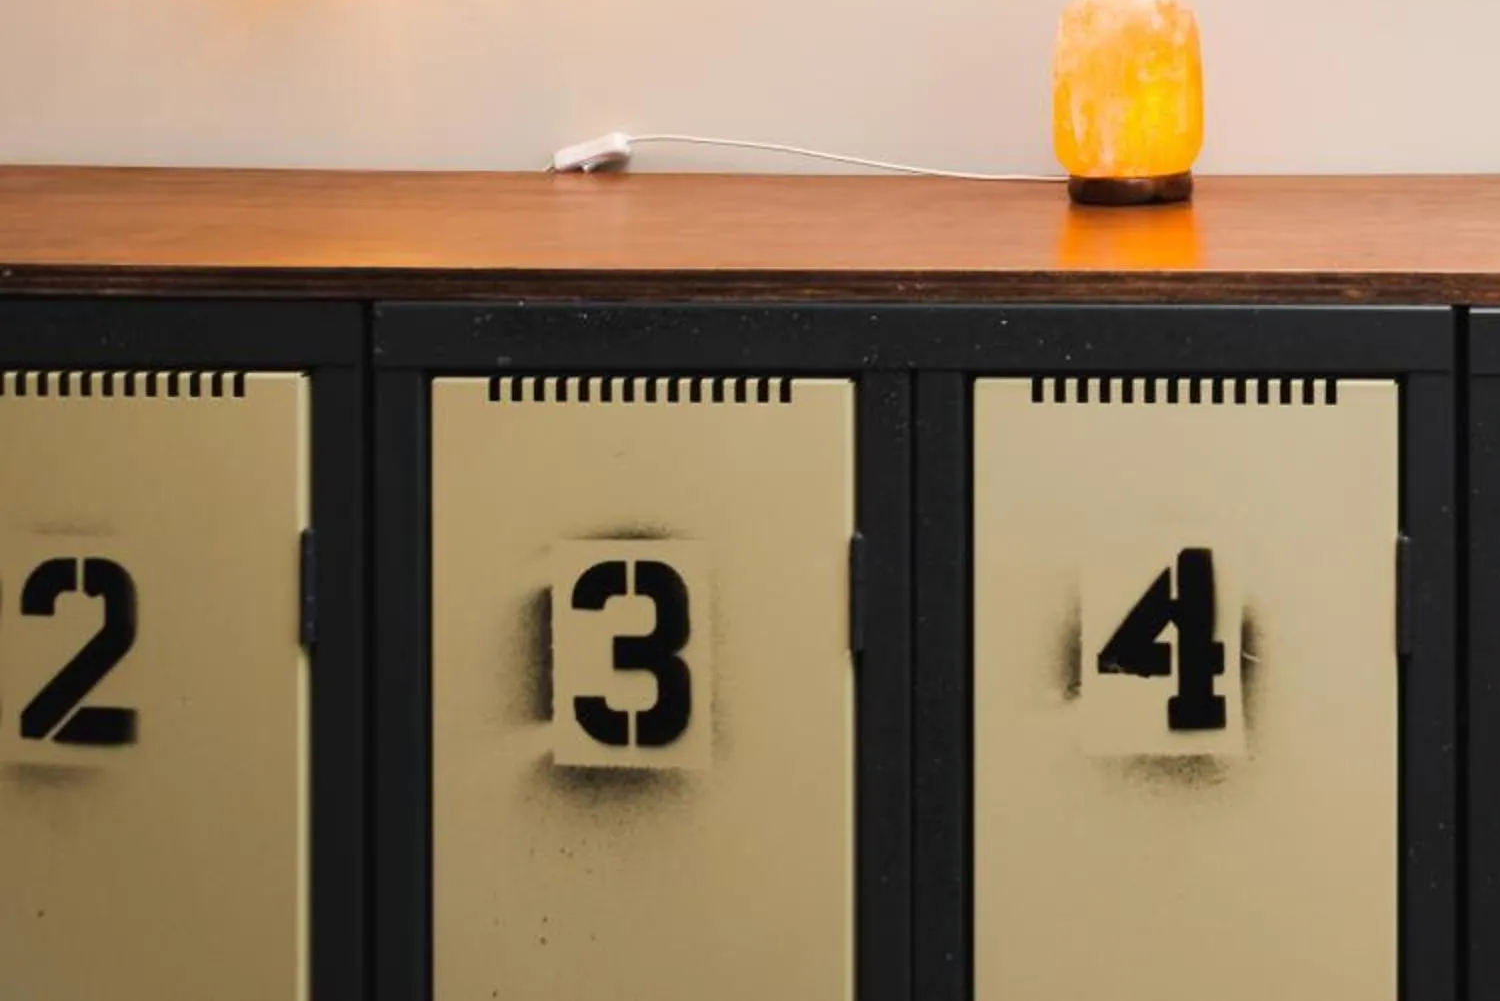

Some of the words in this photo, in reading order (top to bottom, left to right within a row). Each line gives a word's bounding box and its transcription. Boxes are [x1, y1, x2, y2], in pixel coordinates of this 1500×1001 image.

[19, 557, 138, 747] 2
[571, 560, 692, 747] 3
[1097, 548, 1225, 731] 4
